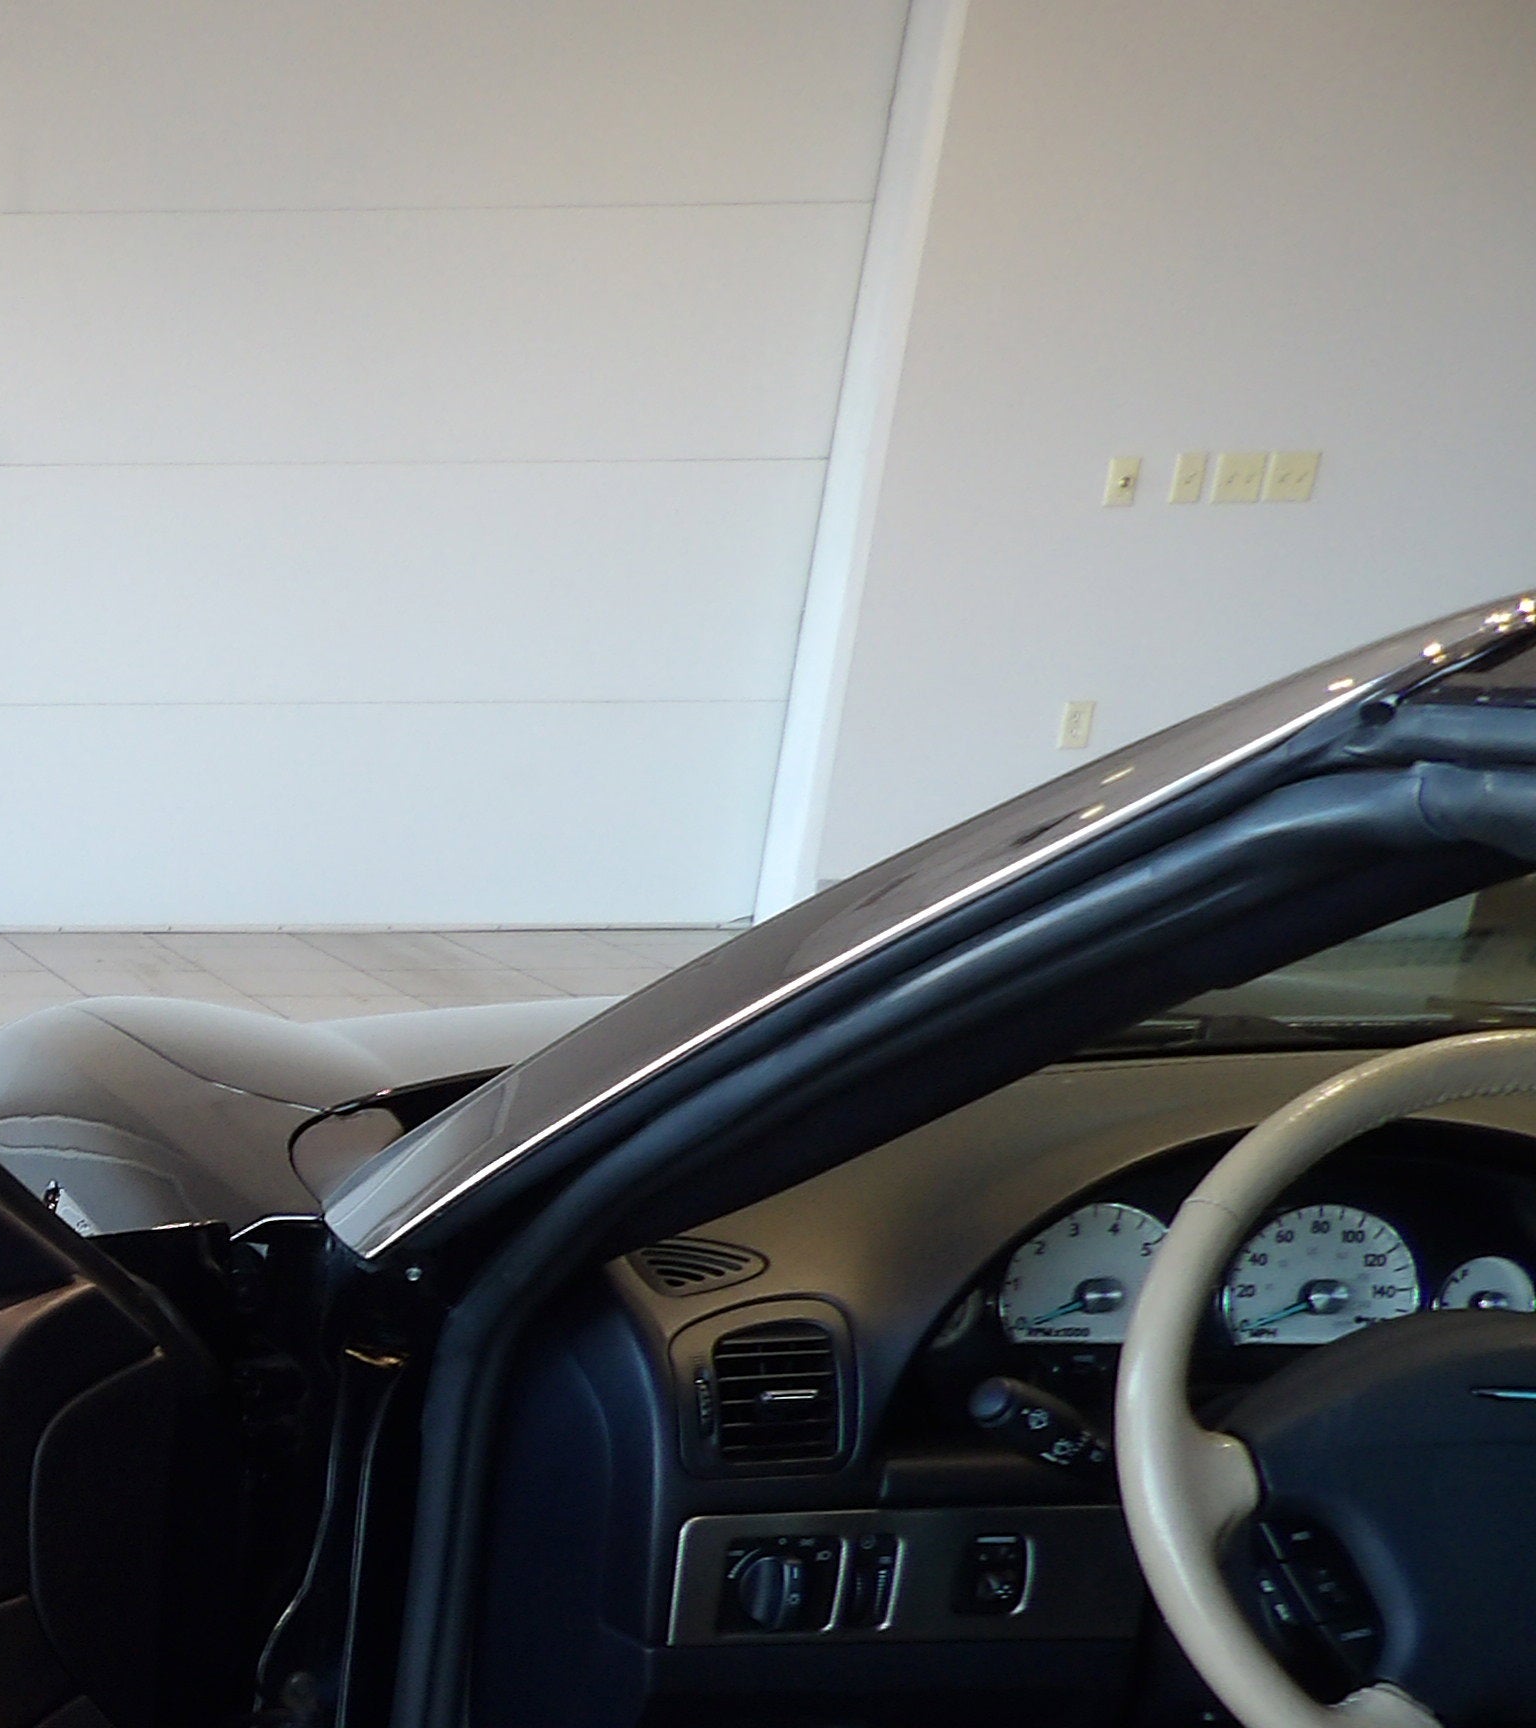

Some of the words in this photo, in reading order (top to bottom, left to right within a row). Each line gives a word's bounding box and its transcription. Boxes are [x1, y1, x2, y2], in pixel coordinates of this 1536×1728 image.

[1069, 1222, 1080, 1237] 3
[1108, 1222, 1119, 1234] 4
[1311, 1220, 1330, 1233] 80
[1275, 1230, 1294, 1243] 60
[1341, 1230, 1365, 1243] 100
[1033, 1241, 1045, 1255] 2
[1140, 1242, 1152, 1257] 5
[1248, 1252, 1268, 1266] 40
[1363, 1253, 1387, 1267] 120
[1237, 1284, 1255, 1298] 20
[1371, 1285, 1396, 1298] 140
